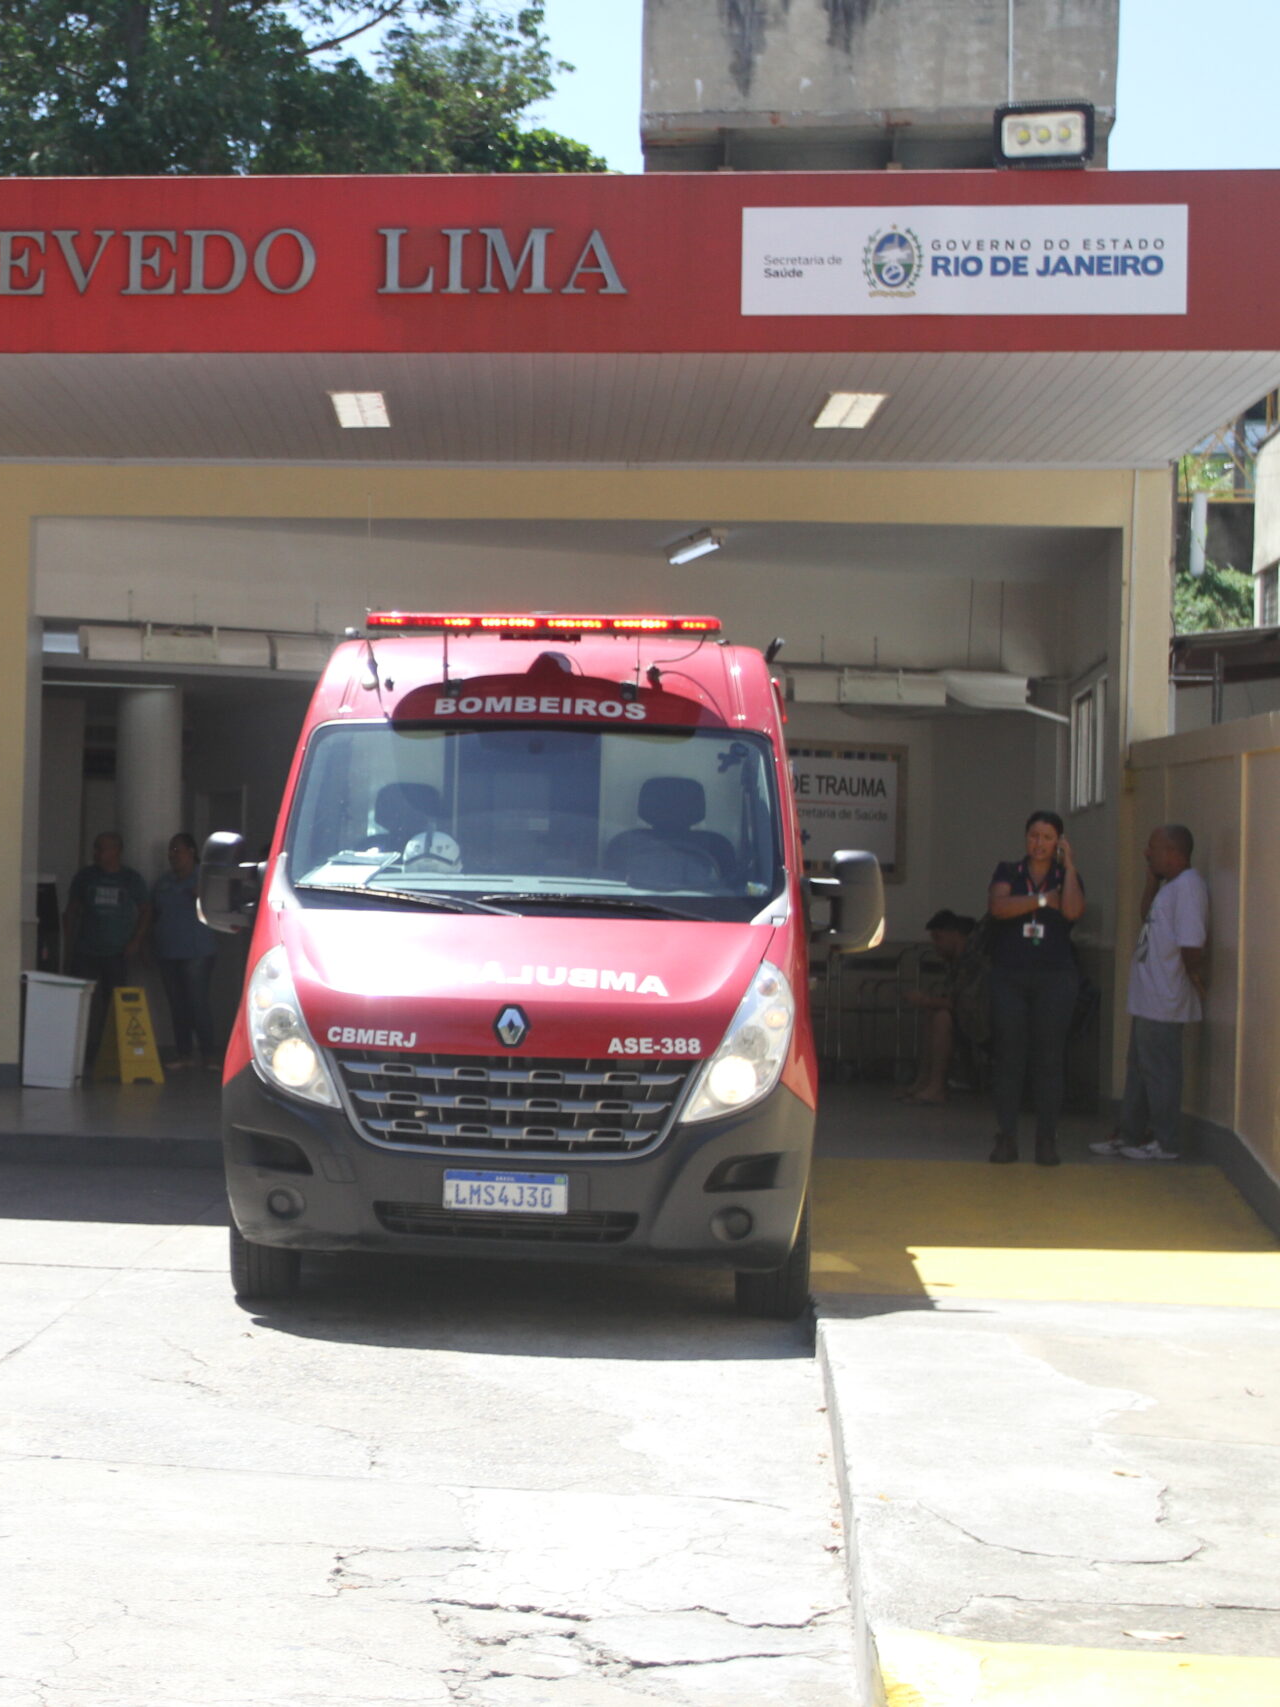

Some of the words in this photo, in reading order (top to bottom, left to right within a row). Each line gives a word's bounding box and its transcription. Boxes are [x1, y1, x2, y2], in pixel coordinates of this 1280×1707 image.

[930, 238, 1033, 252] GOVERNO
[1043, 238, 1071, 251] DO
[1082, 237, 1166, 251] ESTADO
[375, 226, 629, 297] LIMA
[763, 254, 825, 267] Secretaria
[827, 254, 843, 266] de
[930, 255, 984, 278] RIO
[990, 255, 1030, 278] DE
[1036, 254, 1165, 278] JANEIRO
[763, 267, 804, 279] Saúde
[433, 696, 647, 721] BOMBEIROS
[815, 774, 888, 799] TRAUMA
[326, 1025, 418, 1049] CBMERJ
[607, 1037, 702, 1056] ASE-388
[454, 1183, 553, 1209] LMS4J30
